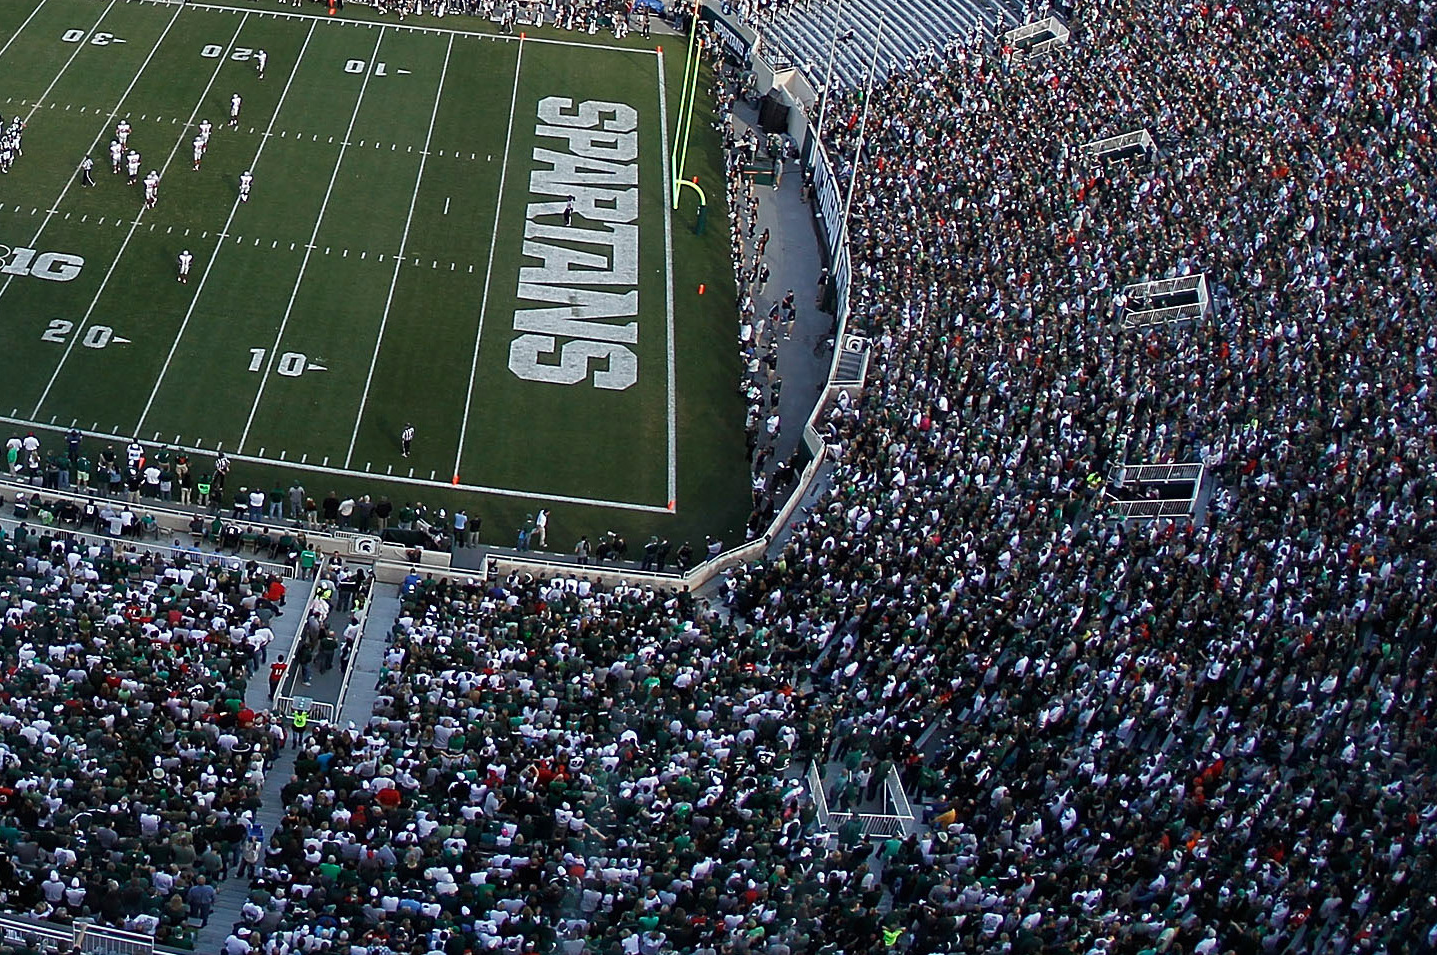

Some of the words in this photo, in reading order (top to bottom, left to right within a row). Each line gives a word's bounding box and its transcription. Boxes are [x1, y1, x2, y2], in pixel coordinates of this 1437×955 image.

[62, 28, 115, 46] 30
[200, 44, 254, 61] 20
[344, 59, 388, 77] 10
[507, 95, 639, 391] SPARTANS
[40, 318, 115, 349] 20
[247, 348, 308, 378] 10
